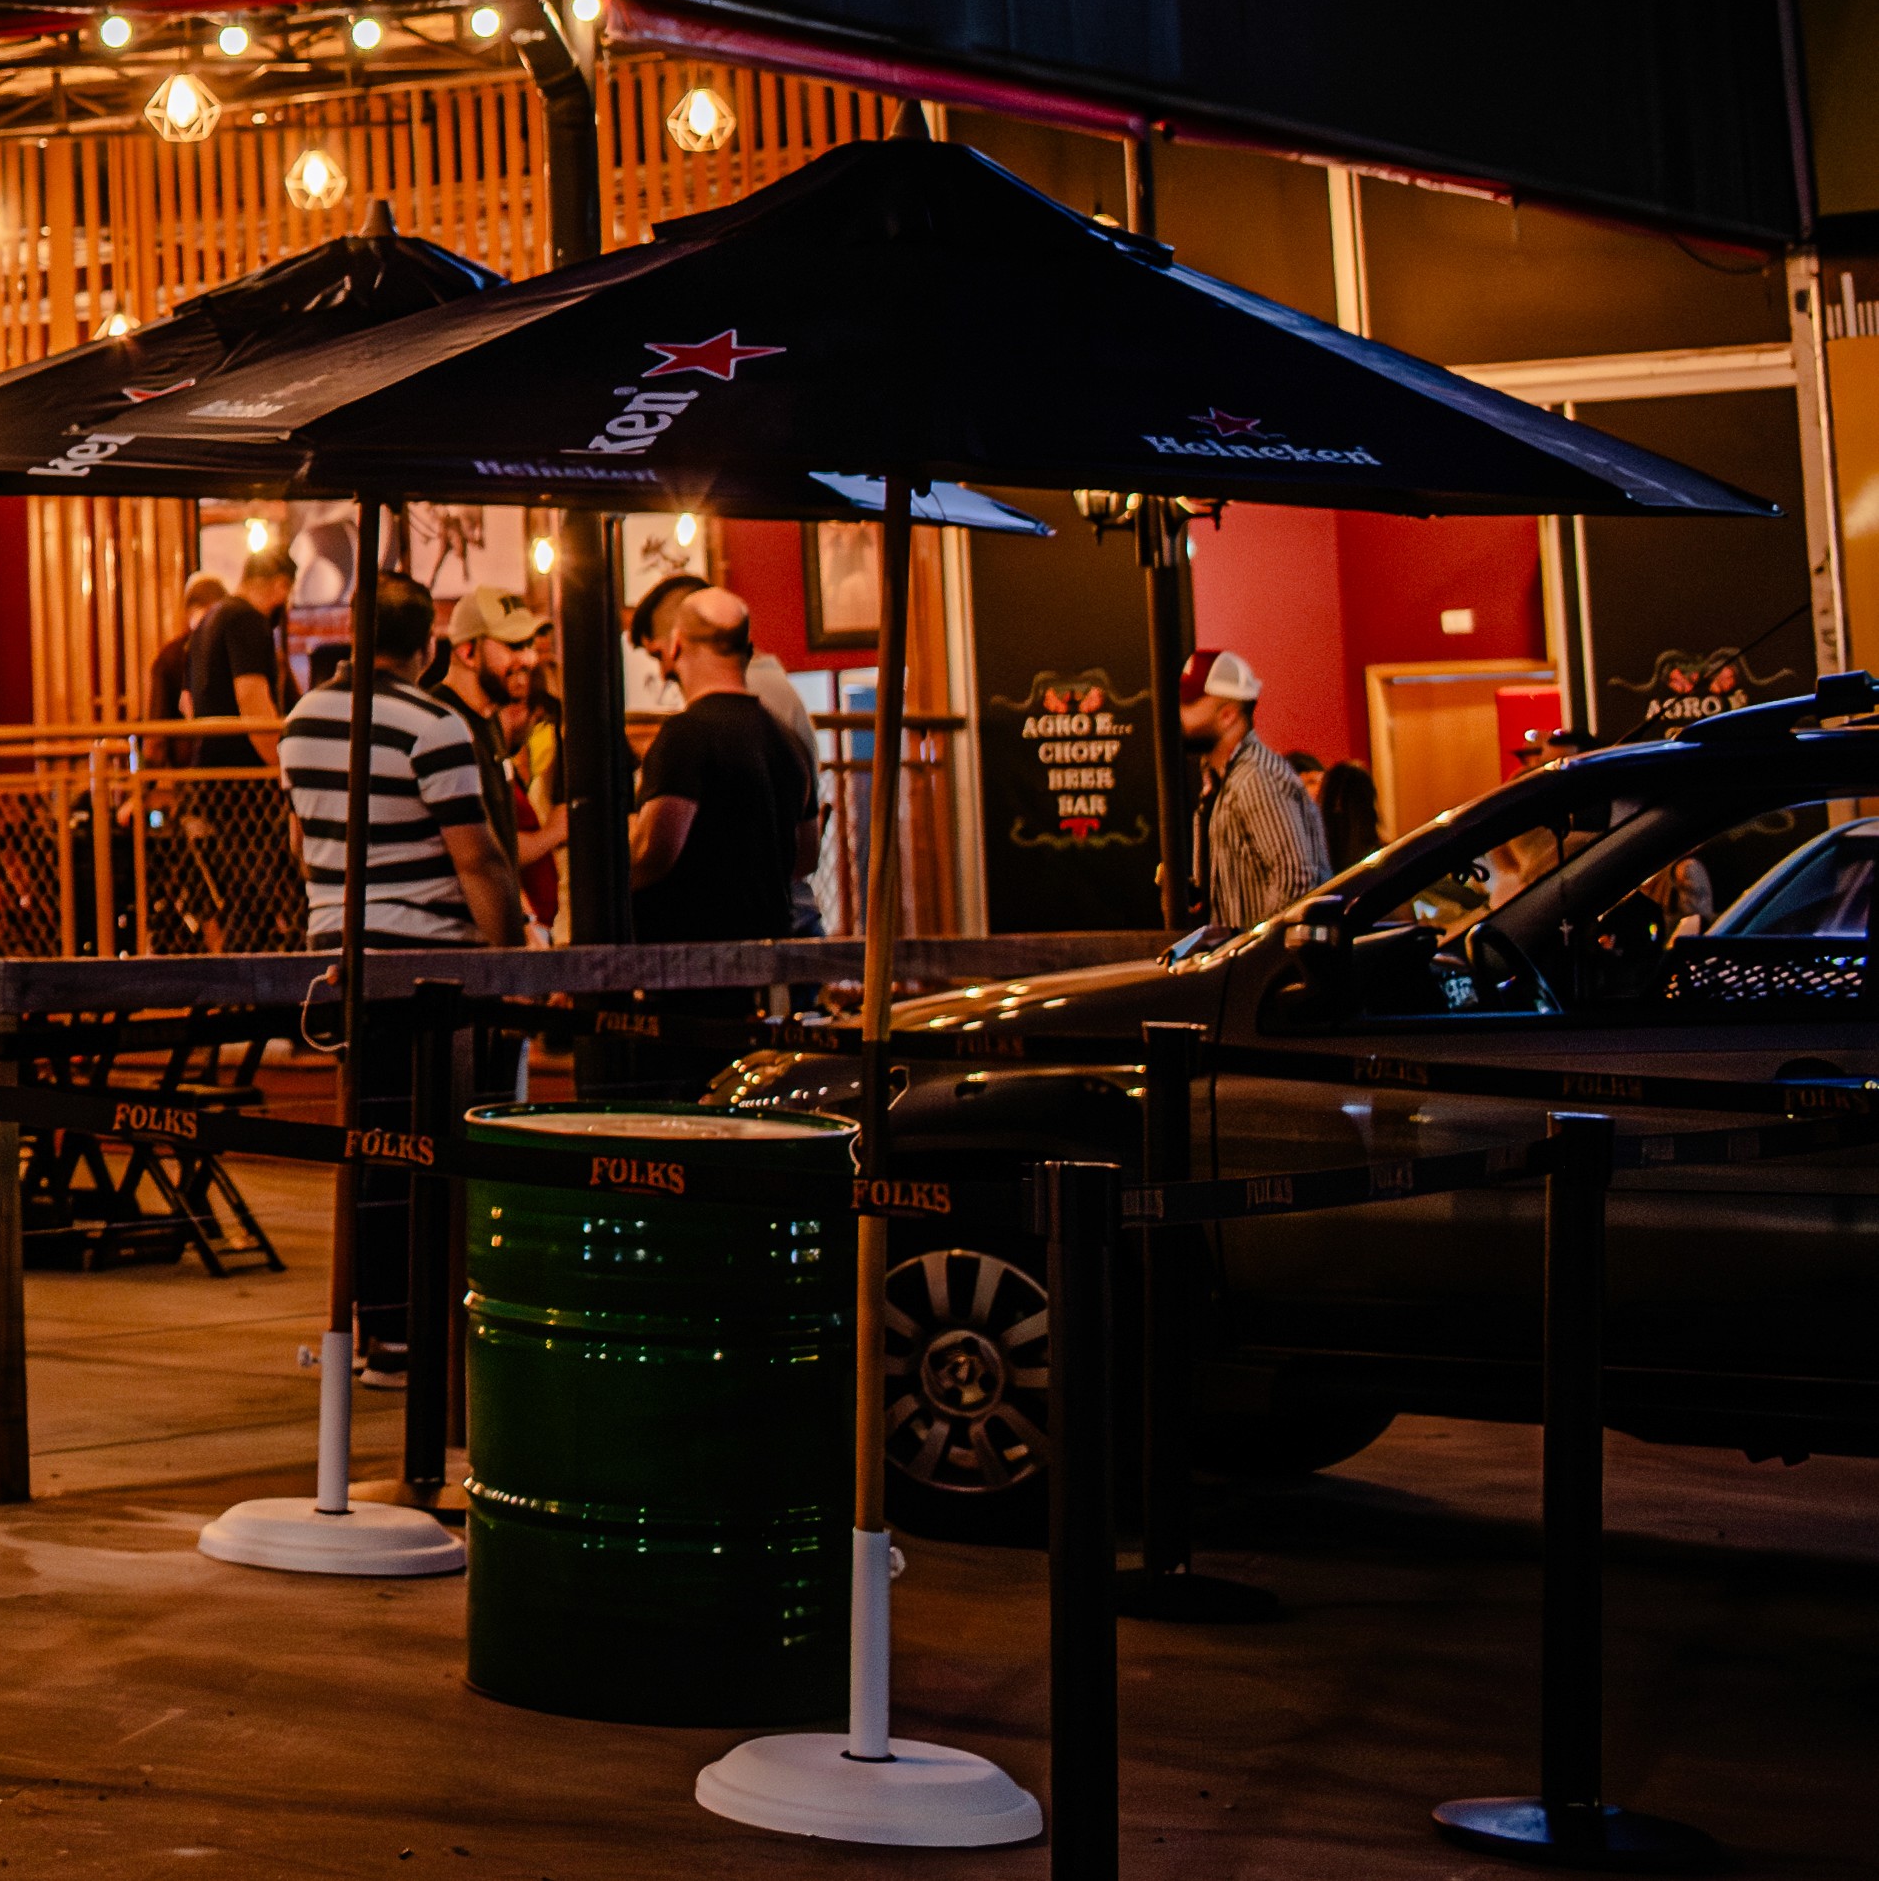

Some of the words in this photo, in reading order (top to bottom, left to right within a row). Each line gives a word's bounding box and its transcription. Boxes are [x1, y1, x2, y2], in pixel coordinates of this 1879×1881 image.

[1141, 434, 1384, 467] Heineken
[1022, 713, 1091, 739] AGRO
[1038, 739, 1122, 765] CHOPP
[1048, 767, 1117, 791] BEER
[1057, 794, 1108, 817] BAR
[111, 1102, 198, 1140] FOLKS
[344, 1128, 435, 1166] FOLKS
[588, 1154, 687, 1196] FOLKS
[851, 1177, 953, 1215] FOLKS
